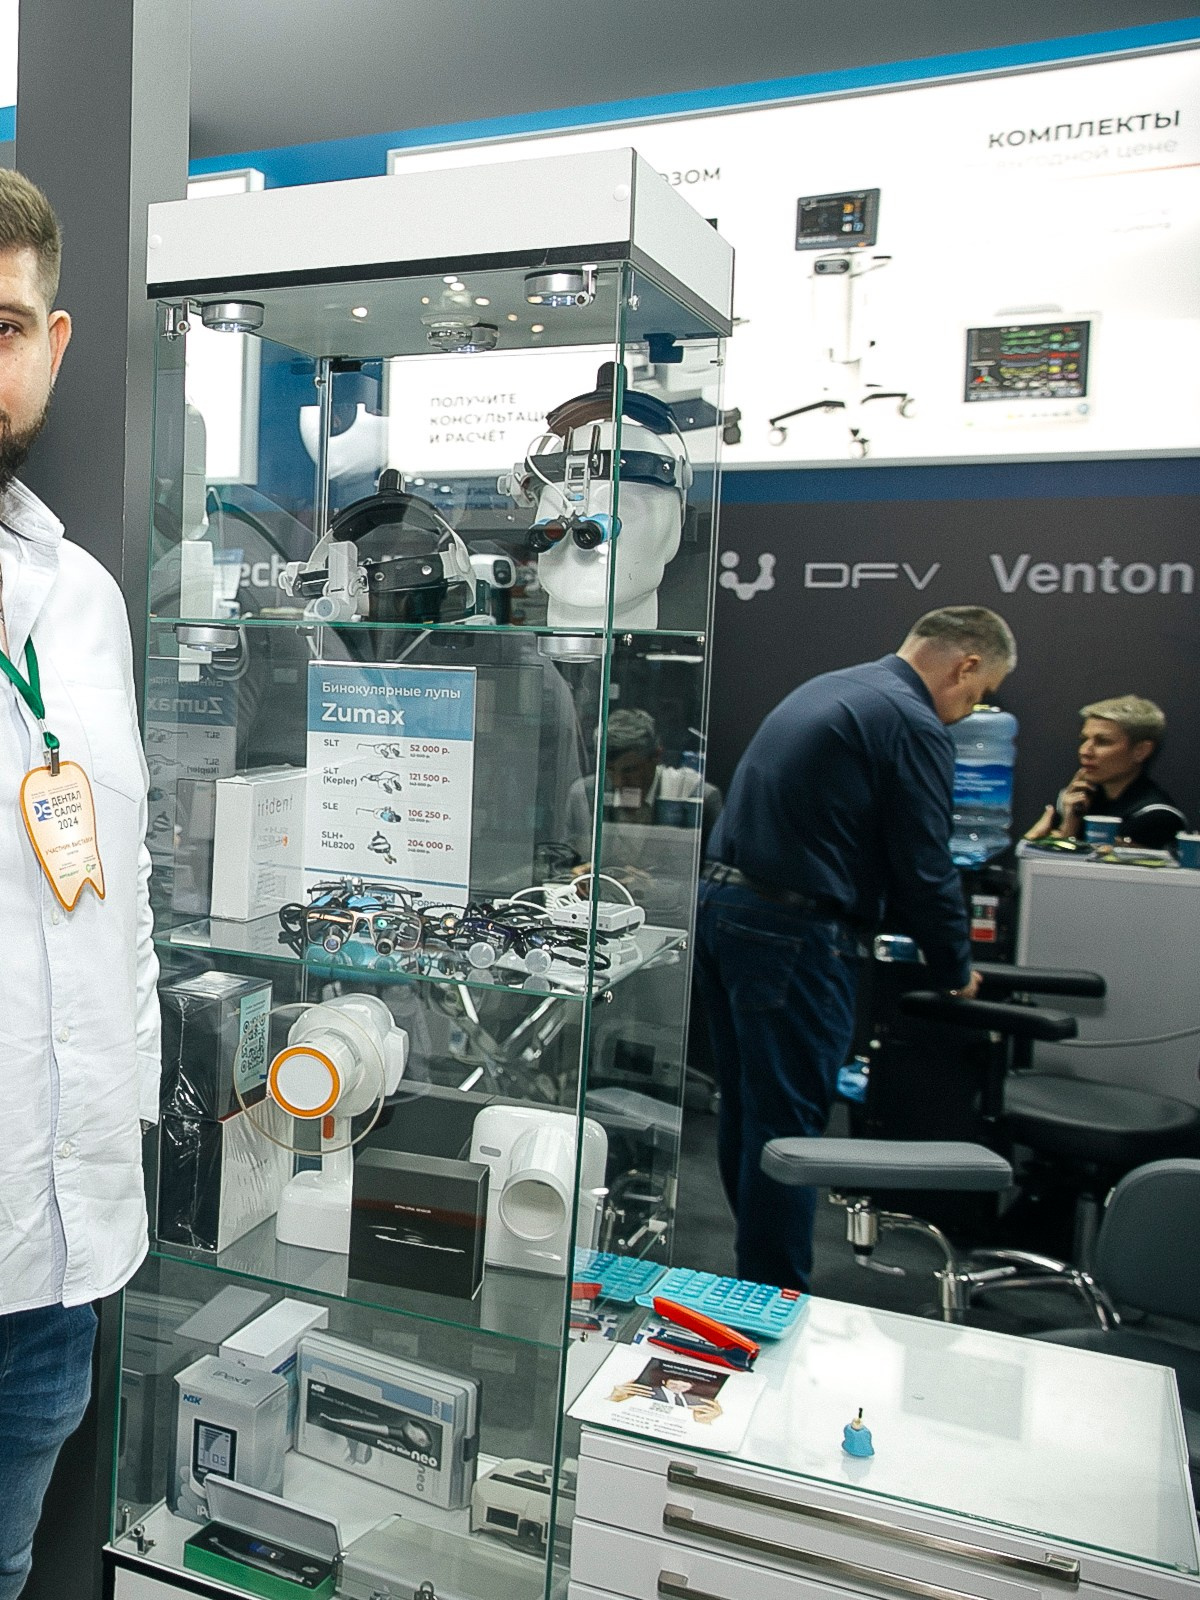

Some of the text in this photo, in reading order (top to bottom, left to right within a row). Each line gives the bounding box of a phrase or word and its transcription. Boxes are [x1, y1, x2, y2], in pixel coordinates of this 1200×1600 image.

[988, 110, 1180, 149] КОМПЛЕКТЫ
[1117, 139, 1179, 160] цене
[430, 393, 517, 408] ПОЛУЧИТЕ
[804, 562, 940, 590] DFV
[990, 553, 1195, 594] Venton
[321, 681, 461, 699] Бинокулярные лупы
[321, 702, 405, 726] Zumax
[323, 739, 339, 748] SLT
[410, 744, 421, 752] 52
[422, 745, 440, 753] 000
[323, 766, 340, 775] SLT
[323, 775, 358, 787] (Kepler)
[409, 773, 421, 781] 121
[423, 774, 440, 782] 500
[52, 791, 81, 806] ДЕНТАЛ
[55, 804, 81, 817] САЛОН
[322, 802, 339, 811] SLE
[408, 809, 423, 818] 106
[424, 811, 442, 819] 250
[58, 818, 78, 830] 2024
[321, 840, 355, 850] HL8200
[407, 839, 424, 848] 204
[425, 841, 443, 850] 000
[183, 1393, 203, 1405] NSK
[411, 1450, 438, 1467] neo
